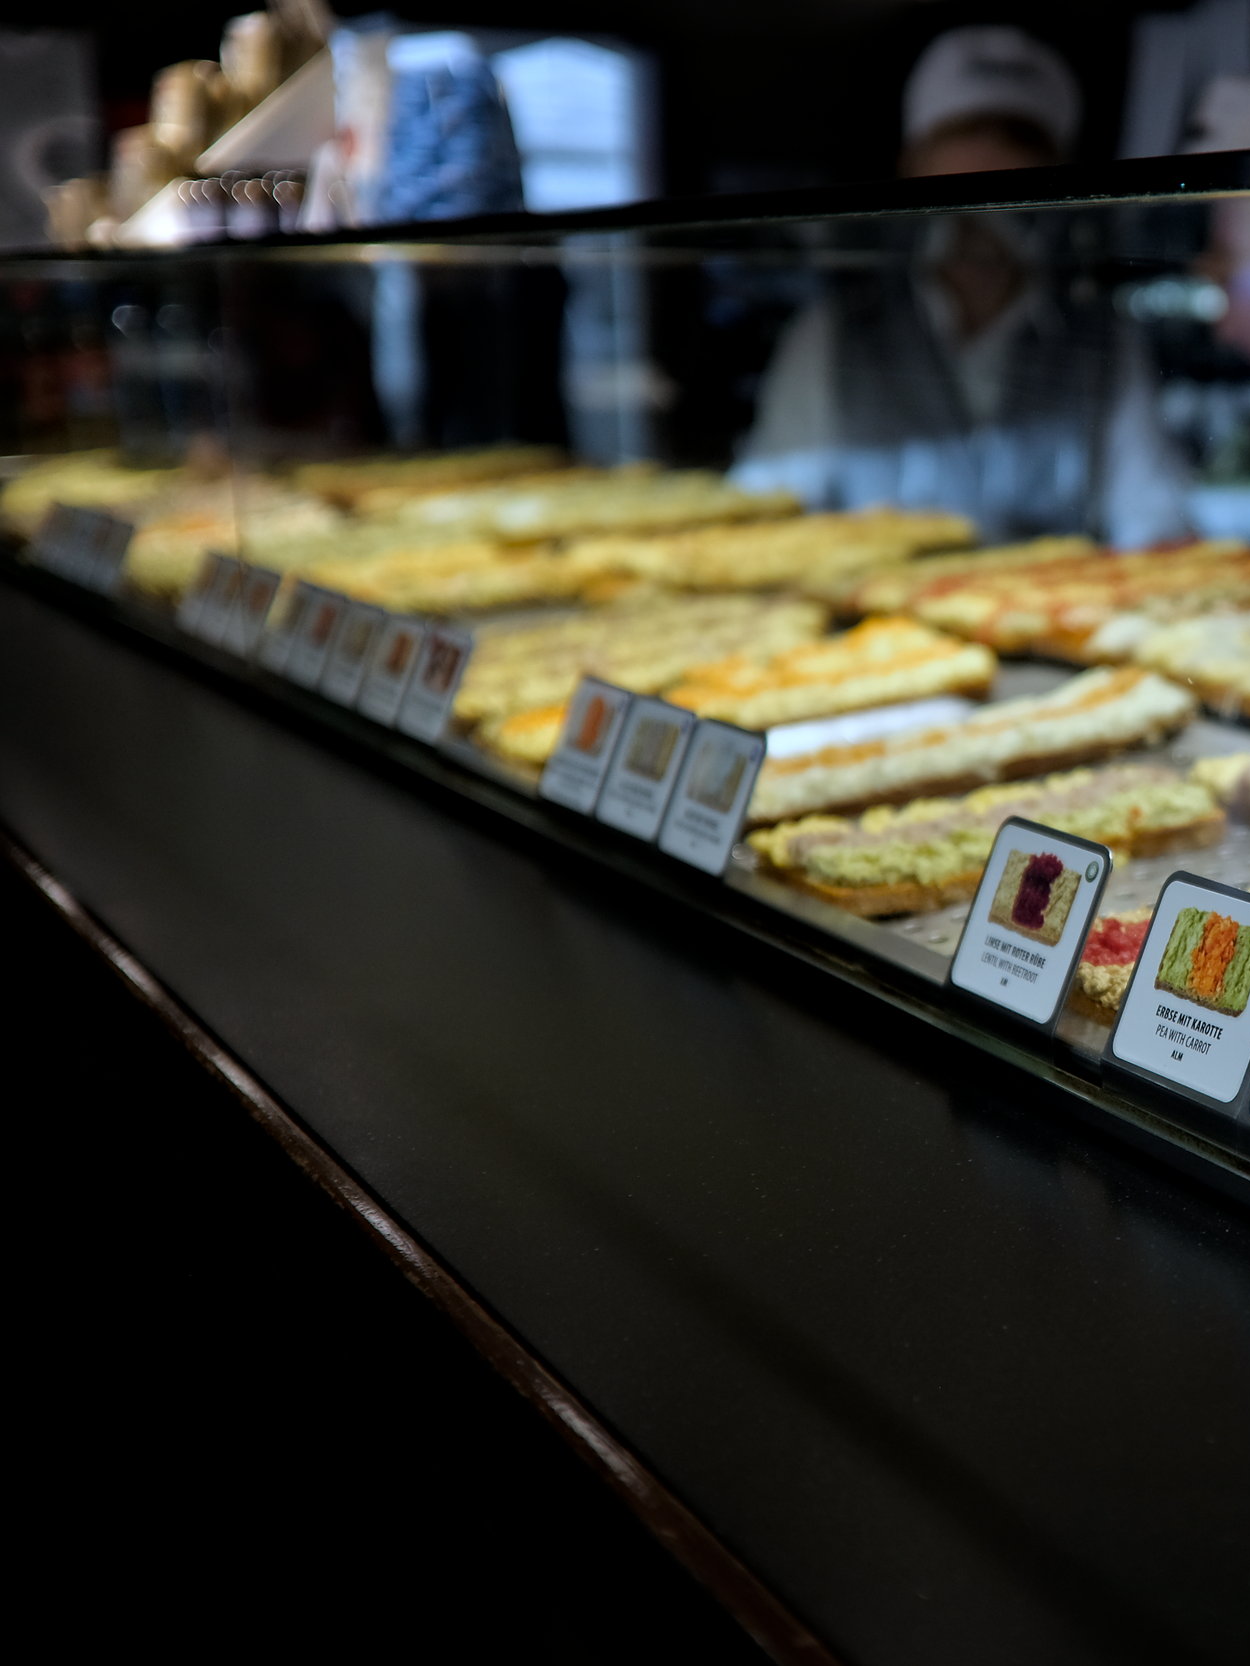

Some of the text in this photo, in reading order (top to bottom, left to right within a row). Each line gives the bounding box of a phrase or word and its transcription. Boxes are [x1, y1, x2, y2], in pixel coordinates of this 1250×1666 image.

[1000, 941, 1012, 954] MIT
[1012, 946, 1030, 963] ROTER
[1029, 952, 1046, 970] RÜBE
[998, 958, 1013, 973] WITH
[1012, 963, 1038, 984] BEETROOT
[1156, 1004, 1224, 1040] ERBSE MIT KAROTTE
[1155, 1024, 1211, 1054] PEA WITH CARROT
[1171, 1050, 1184, 1062] ALM
